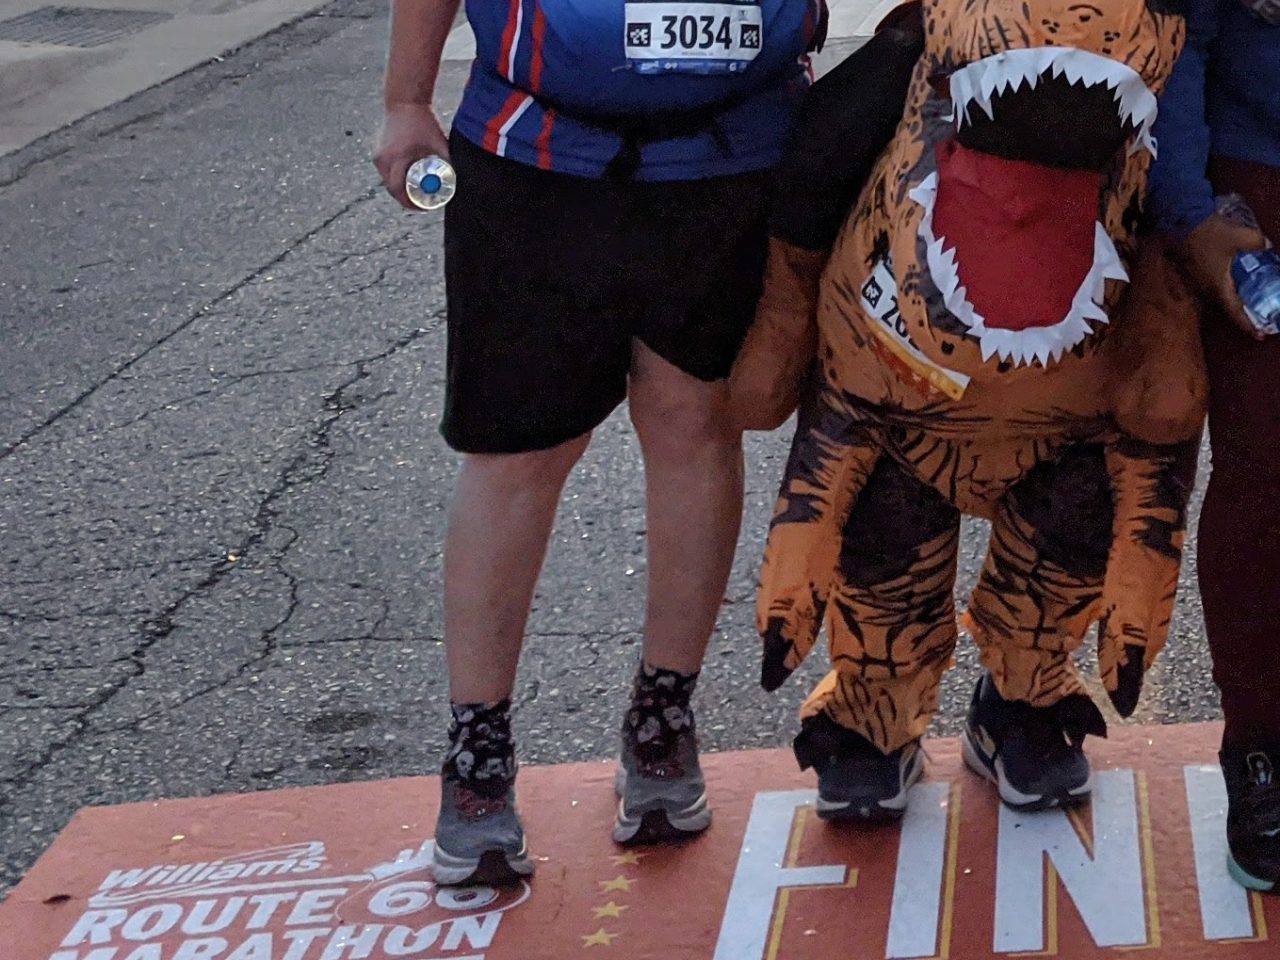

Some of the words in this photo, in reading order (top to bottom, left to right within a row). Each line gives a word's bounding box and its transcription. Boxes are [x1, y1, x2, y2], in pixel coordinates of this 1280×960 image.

[660, 14, 733, 50] 3034
[100, 854, 328, 890] Williams
[58, 887, 348, 948] ROUTE
